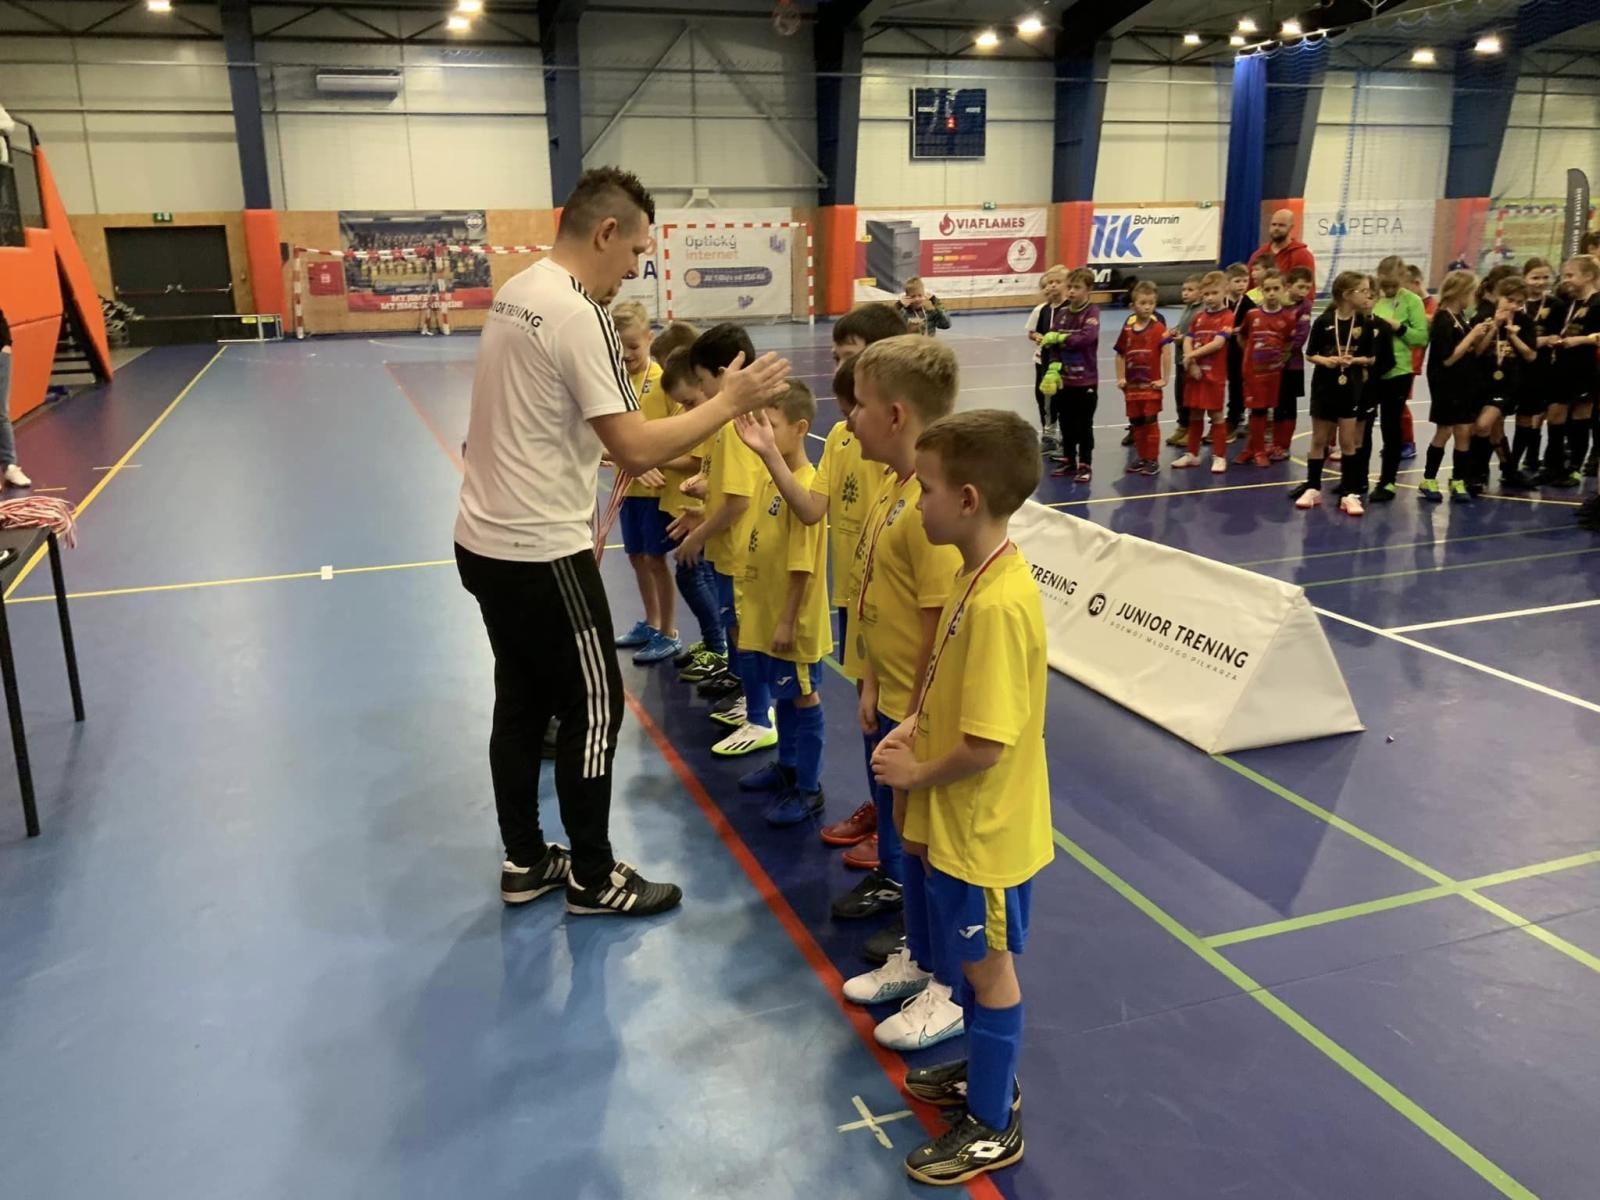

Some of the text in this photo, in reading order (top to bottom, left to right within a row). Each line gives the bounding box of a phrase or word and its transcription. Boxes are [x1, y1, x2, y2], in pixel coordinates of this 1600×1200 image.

[956, 217, 1025, 230] VIAFLAMES
[1030, 564, 1078, 595] TRENING
[1116, 602, 1249, 668] JUNIOR TRENING
